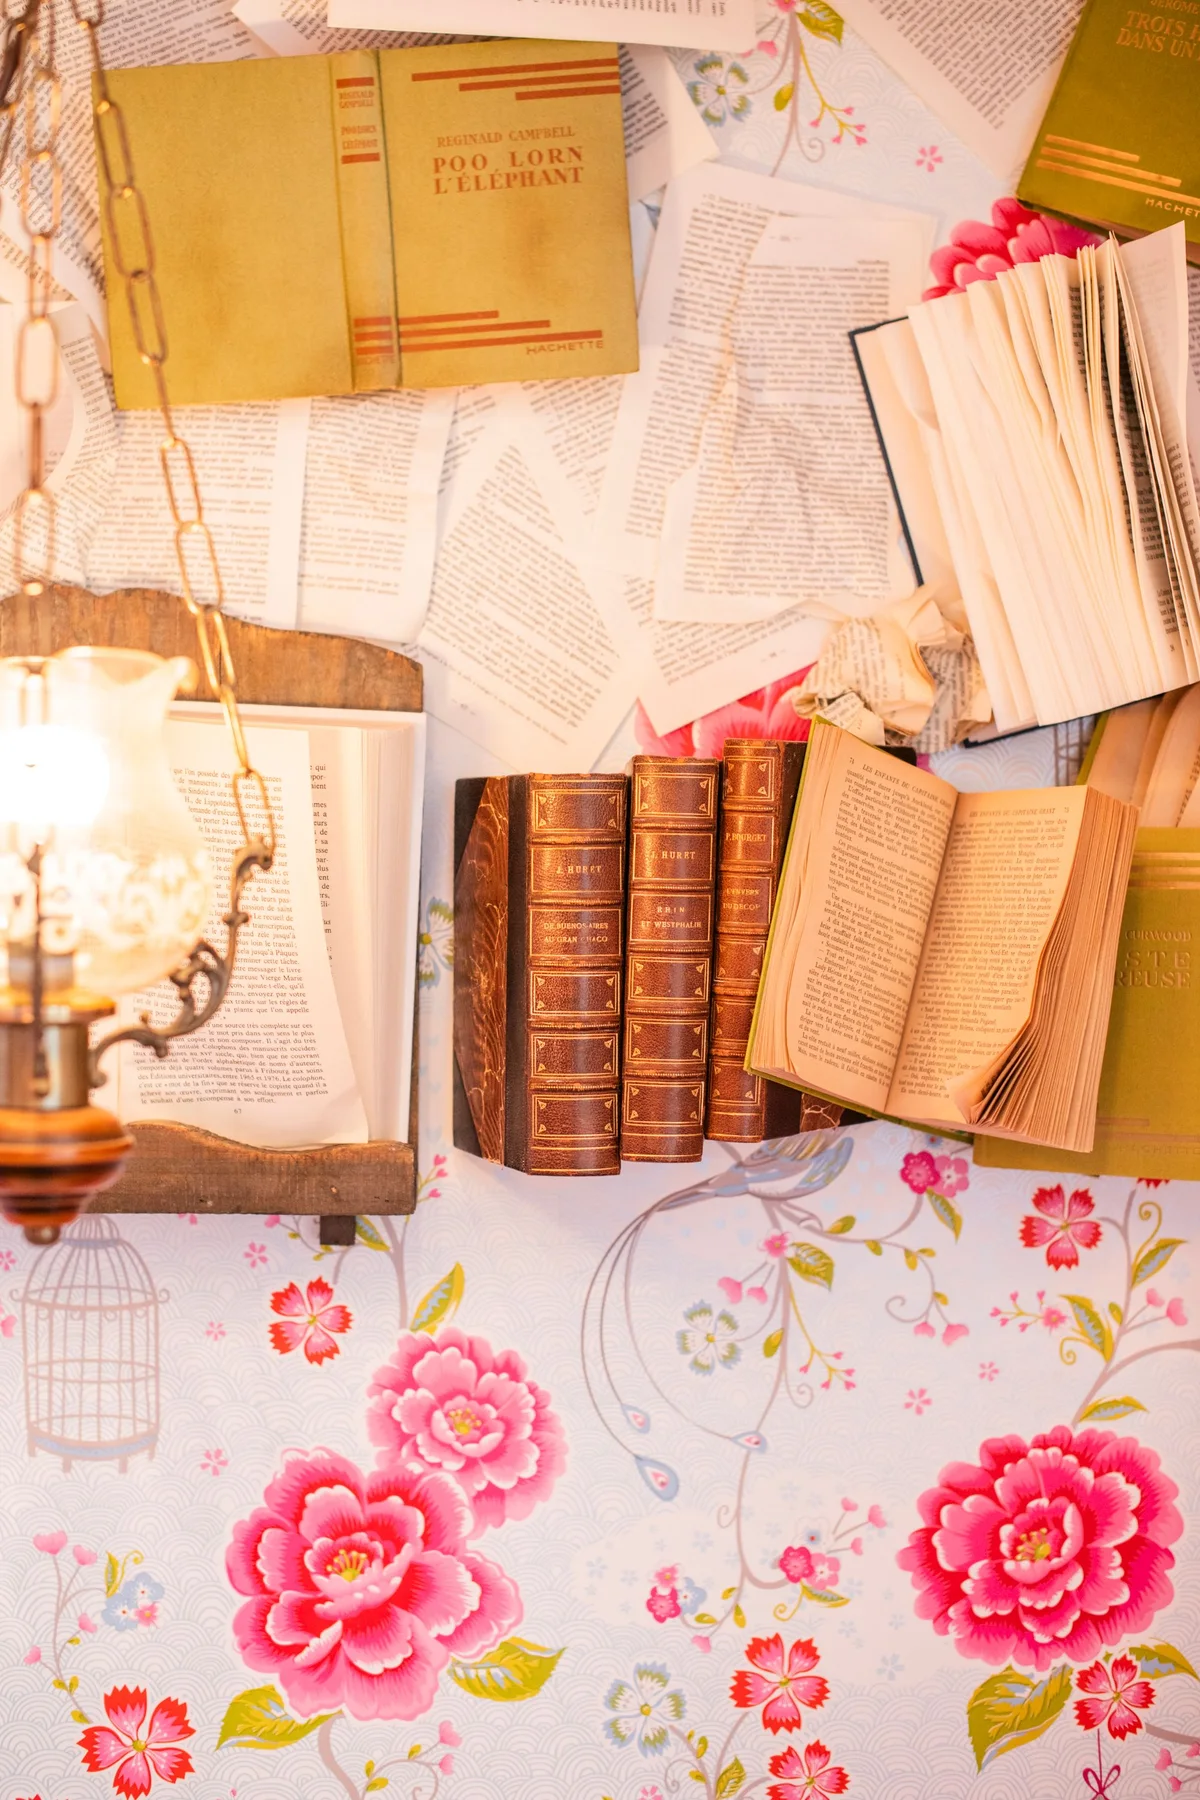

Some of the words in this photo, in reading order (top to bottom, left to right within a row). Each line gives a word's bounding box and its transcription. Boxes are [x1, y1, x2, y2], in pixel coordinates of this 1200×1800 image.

[1126, 10, 1186, 37] TROIS
[1116, 28, 1165, 52] DANS
[1170, 39, 1196, 58] UN
[436, 132, 502, 147] REGINALD
[508, 126, 575, 141] CAMPBELL
[432, 154, 488, 174] POO
[508, 146, 583, 167] LORN
[433, 167, 584, 195] L'ÉLÉPHANT
[526, 339, 604, 355] HACHETTE
[862, 764, 873, 773] LES
[874, 770, 899, 785] ENFANTS
[1125, 930, 1192, 942] CURWOOD
